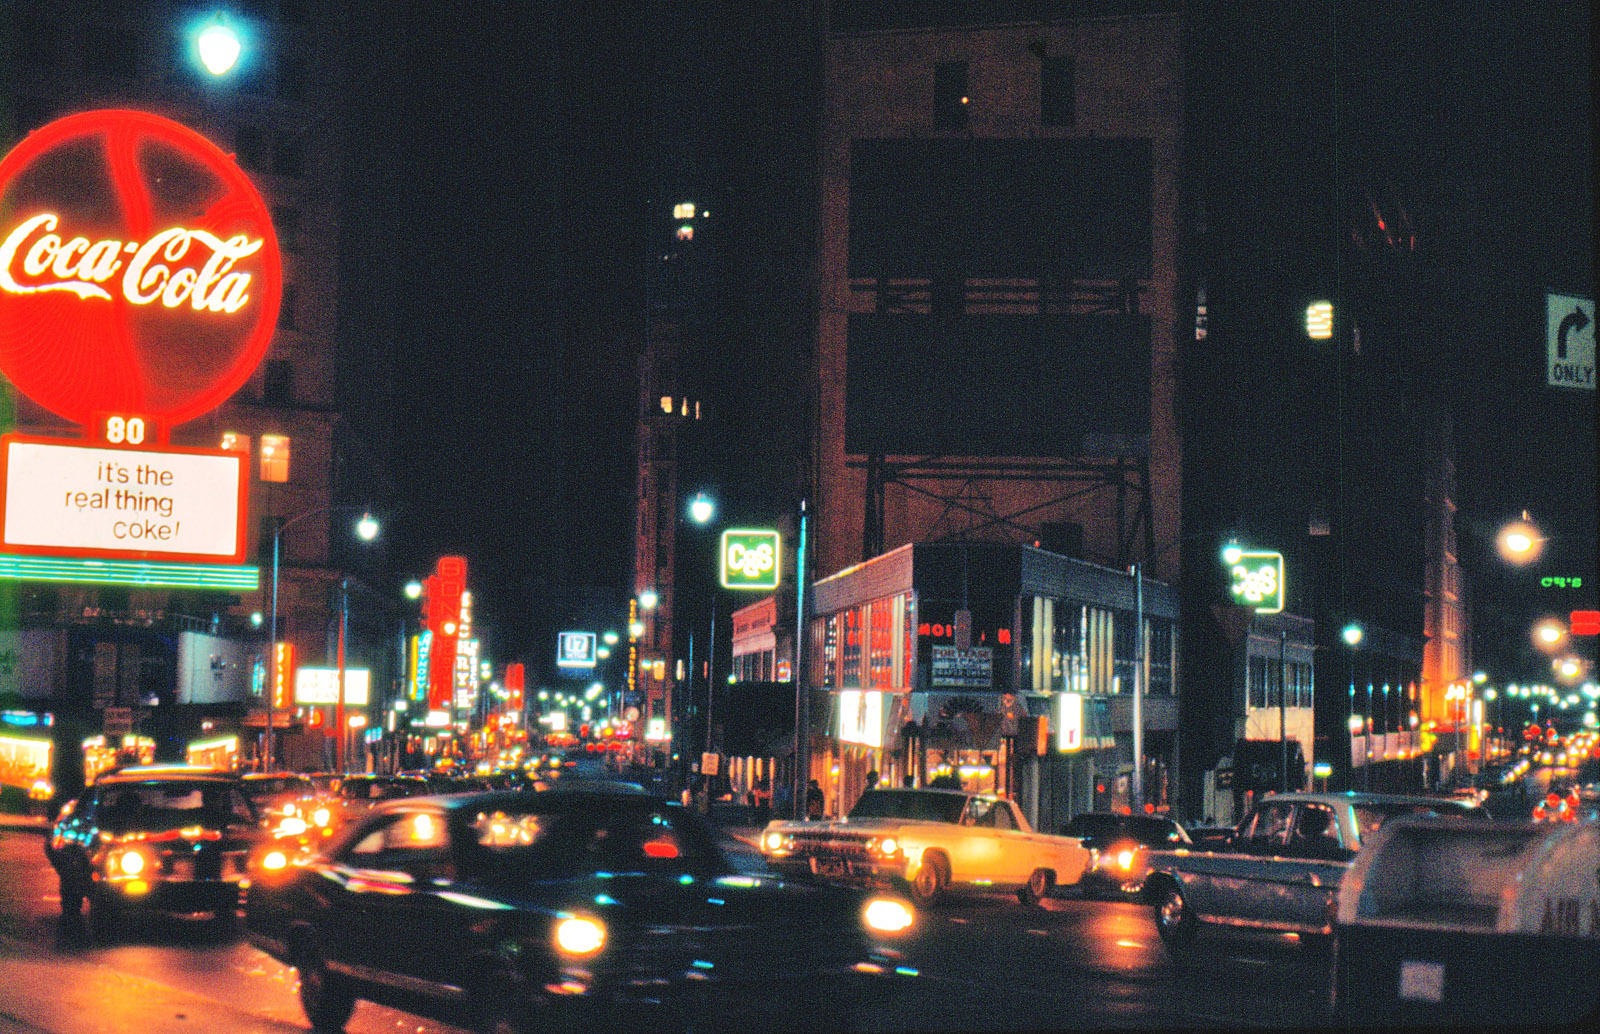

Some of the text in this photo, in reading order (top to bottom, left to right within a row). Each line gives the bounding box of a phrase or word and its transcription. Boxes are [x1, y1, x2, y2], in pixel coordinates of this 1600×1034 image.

[0, 213, 264, 313] Coca-Cola
[1553, 363, 1594, 383] ONLY
[106, 415, 145, 444] 80
[97, 461, 174, 486] it's the
[65, 488, 174, 517] real thing
[113, 519, 180, 540] coke!
